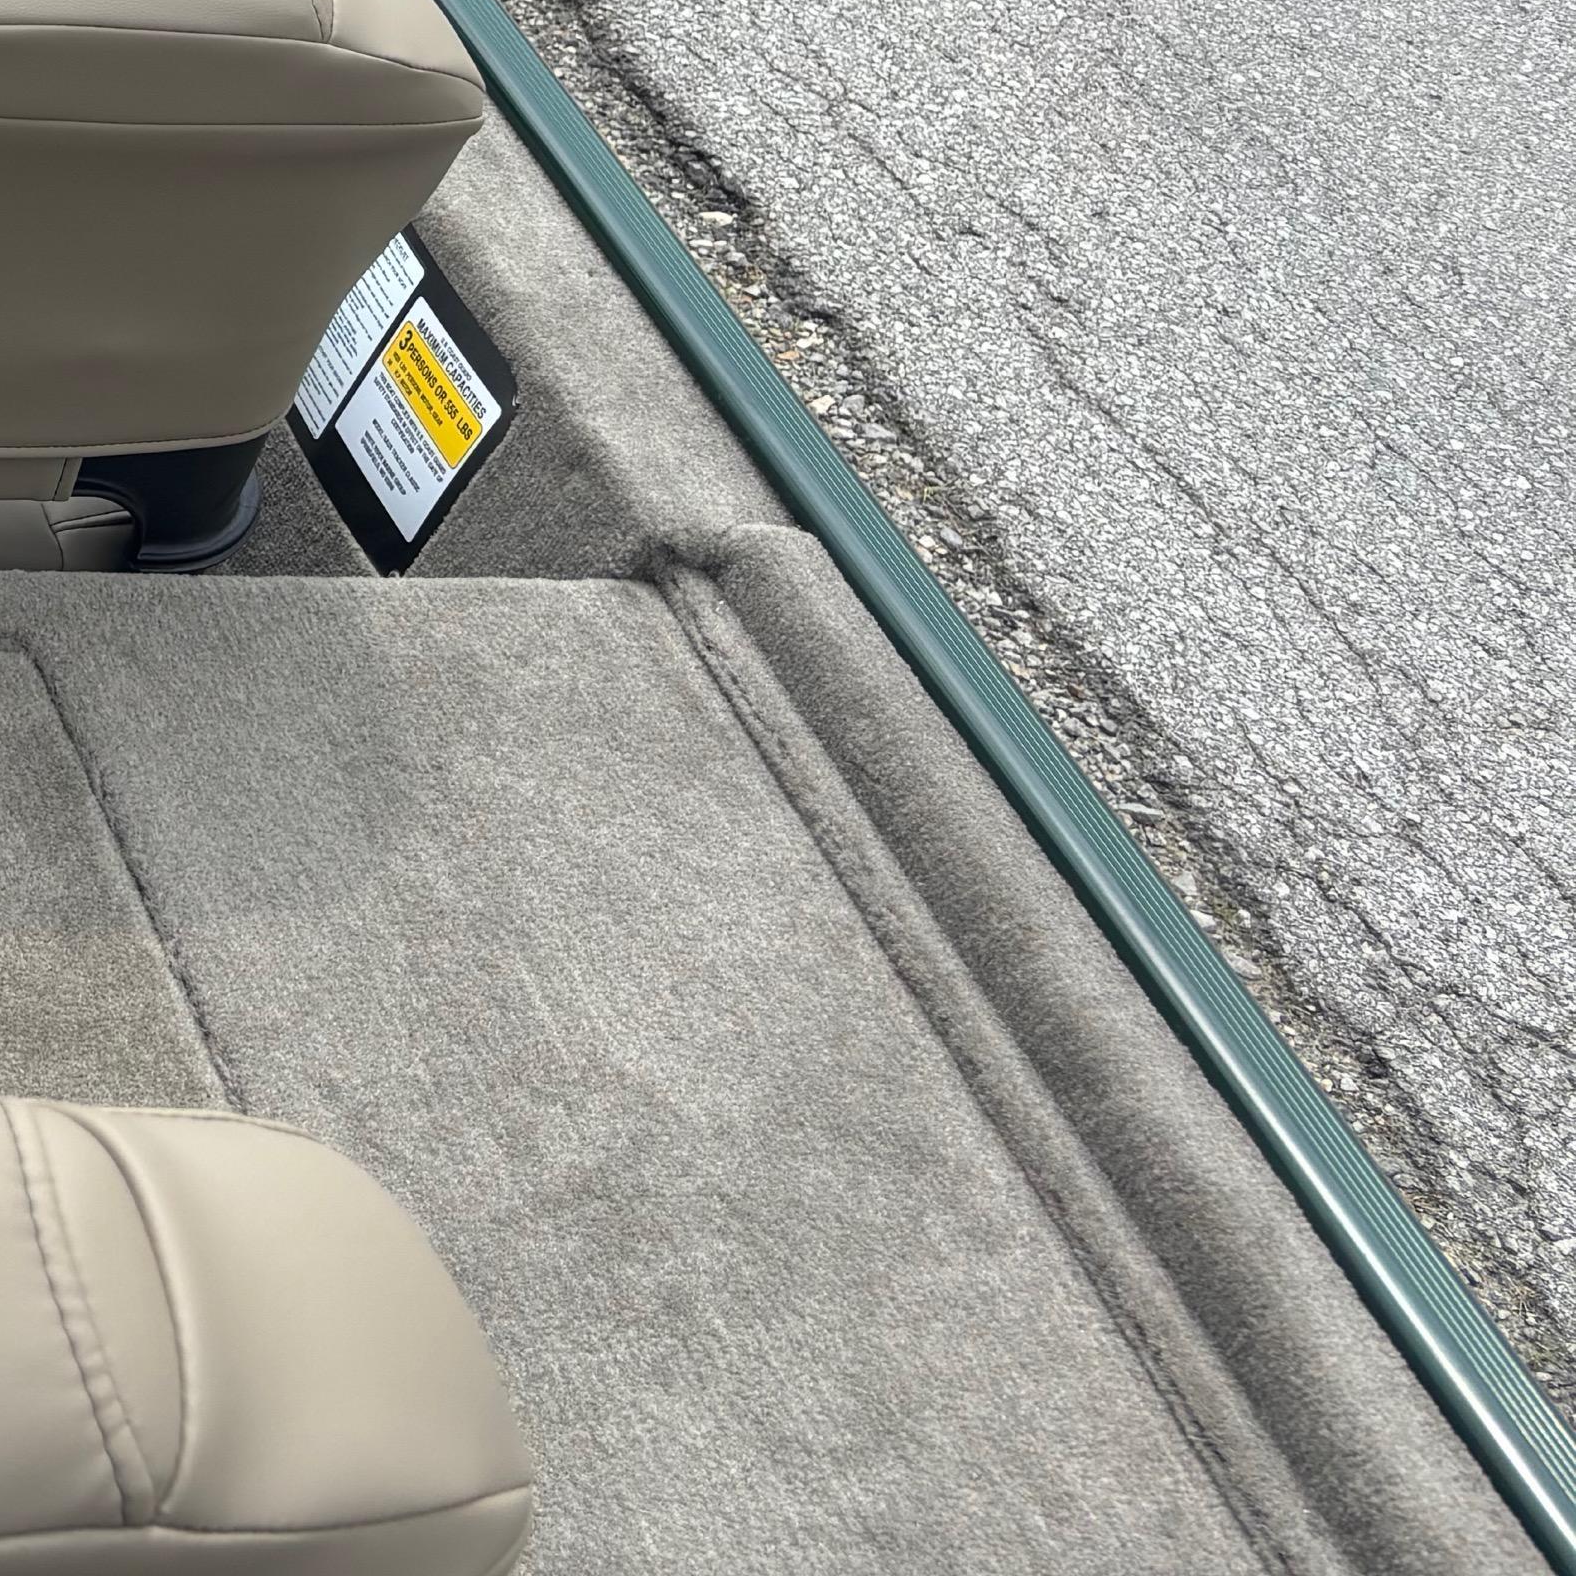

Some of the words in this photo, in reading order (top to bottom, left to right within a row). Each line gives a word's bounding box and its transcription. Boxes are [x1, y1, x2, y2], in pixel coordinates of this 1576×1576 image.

[397, 328, 414, 352] 3
[405, 341, 438, 389] PERSONS
[415, 317, 449, 365] MAXIMUM
[444, 360, 487, 420] CAPACITIES
[433, 383, 448, 404] OR
[443, 398, 458, 420] 555
[456, 416, 473, 441] LBS
